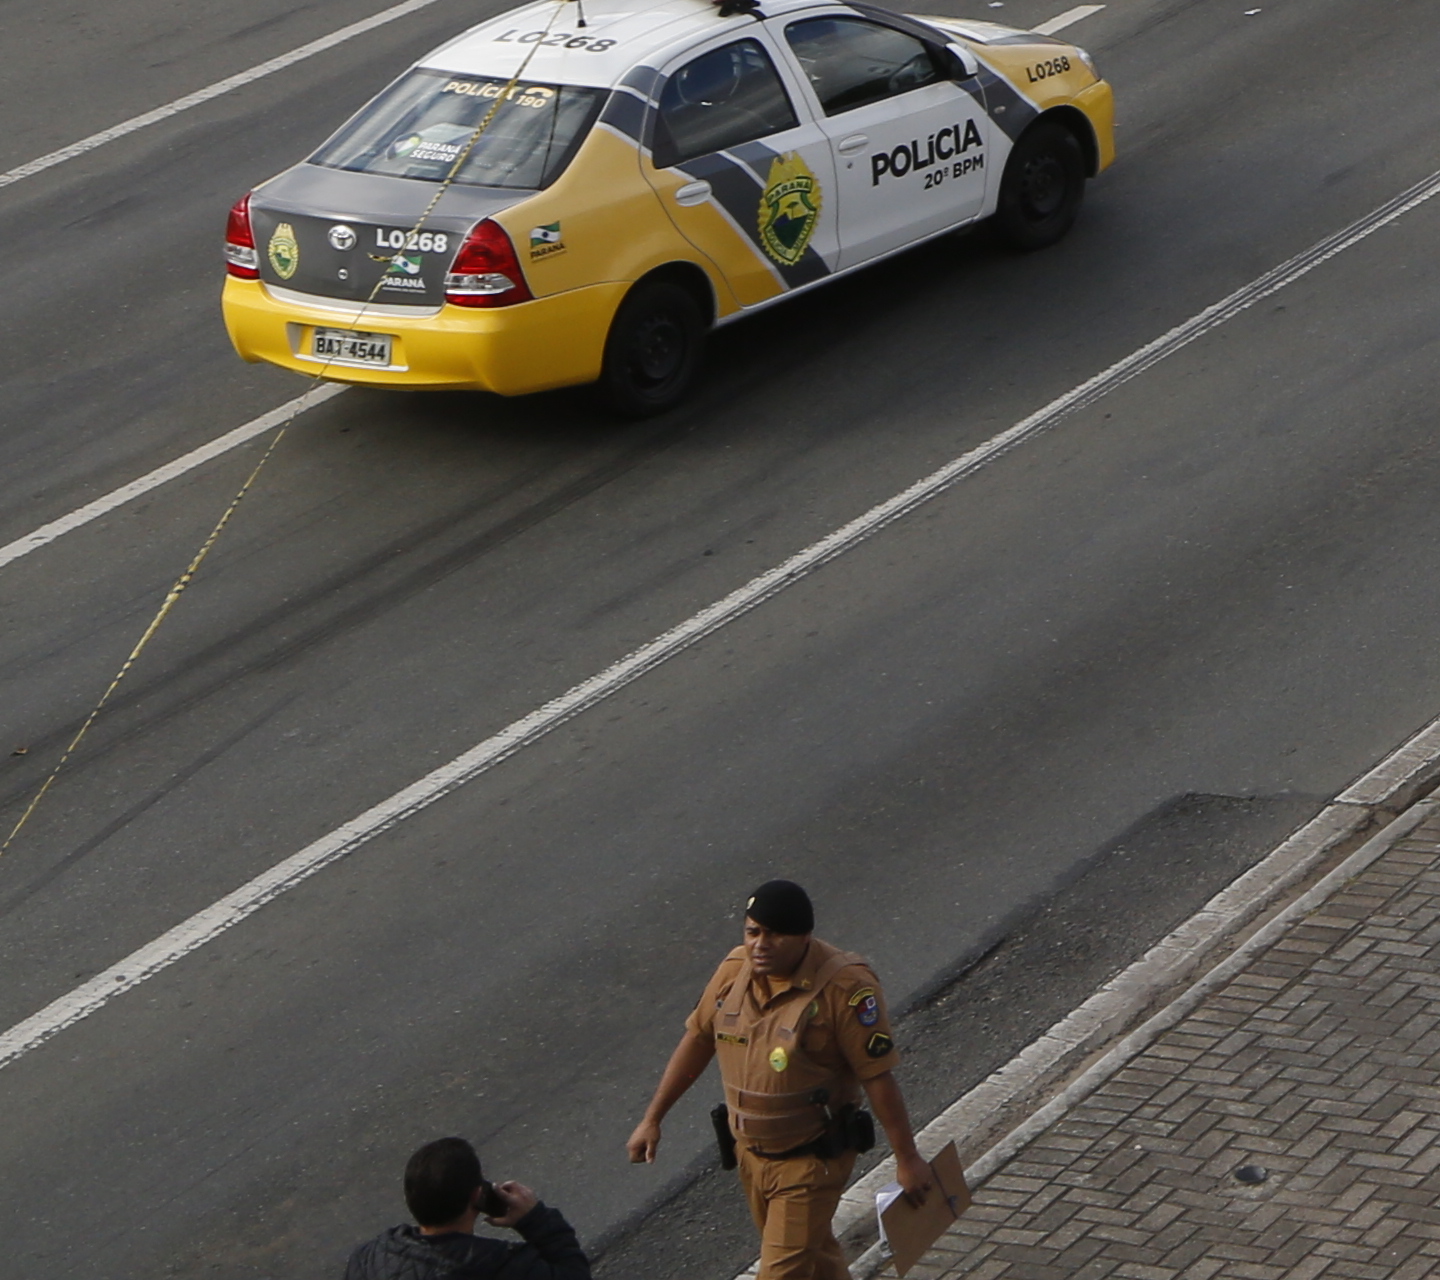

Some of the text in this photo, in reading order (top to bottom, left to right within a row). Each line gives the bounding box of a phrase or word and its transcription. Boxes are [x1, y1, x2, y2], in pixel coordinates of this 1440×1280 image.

[445, 79, 547, 109] POLÍCIA 190
[410, 148, 456, 162] SEGURO
[418, 141, 462, 154] PARANÁ
[871, 118, 984, 186] POLÍCIA
[953, 153, 985, 180] BPM
[316, 337, 386, 361] BAT-4544
